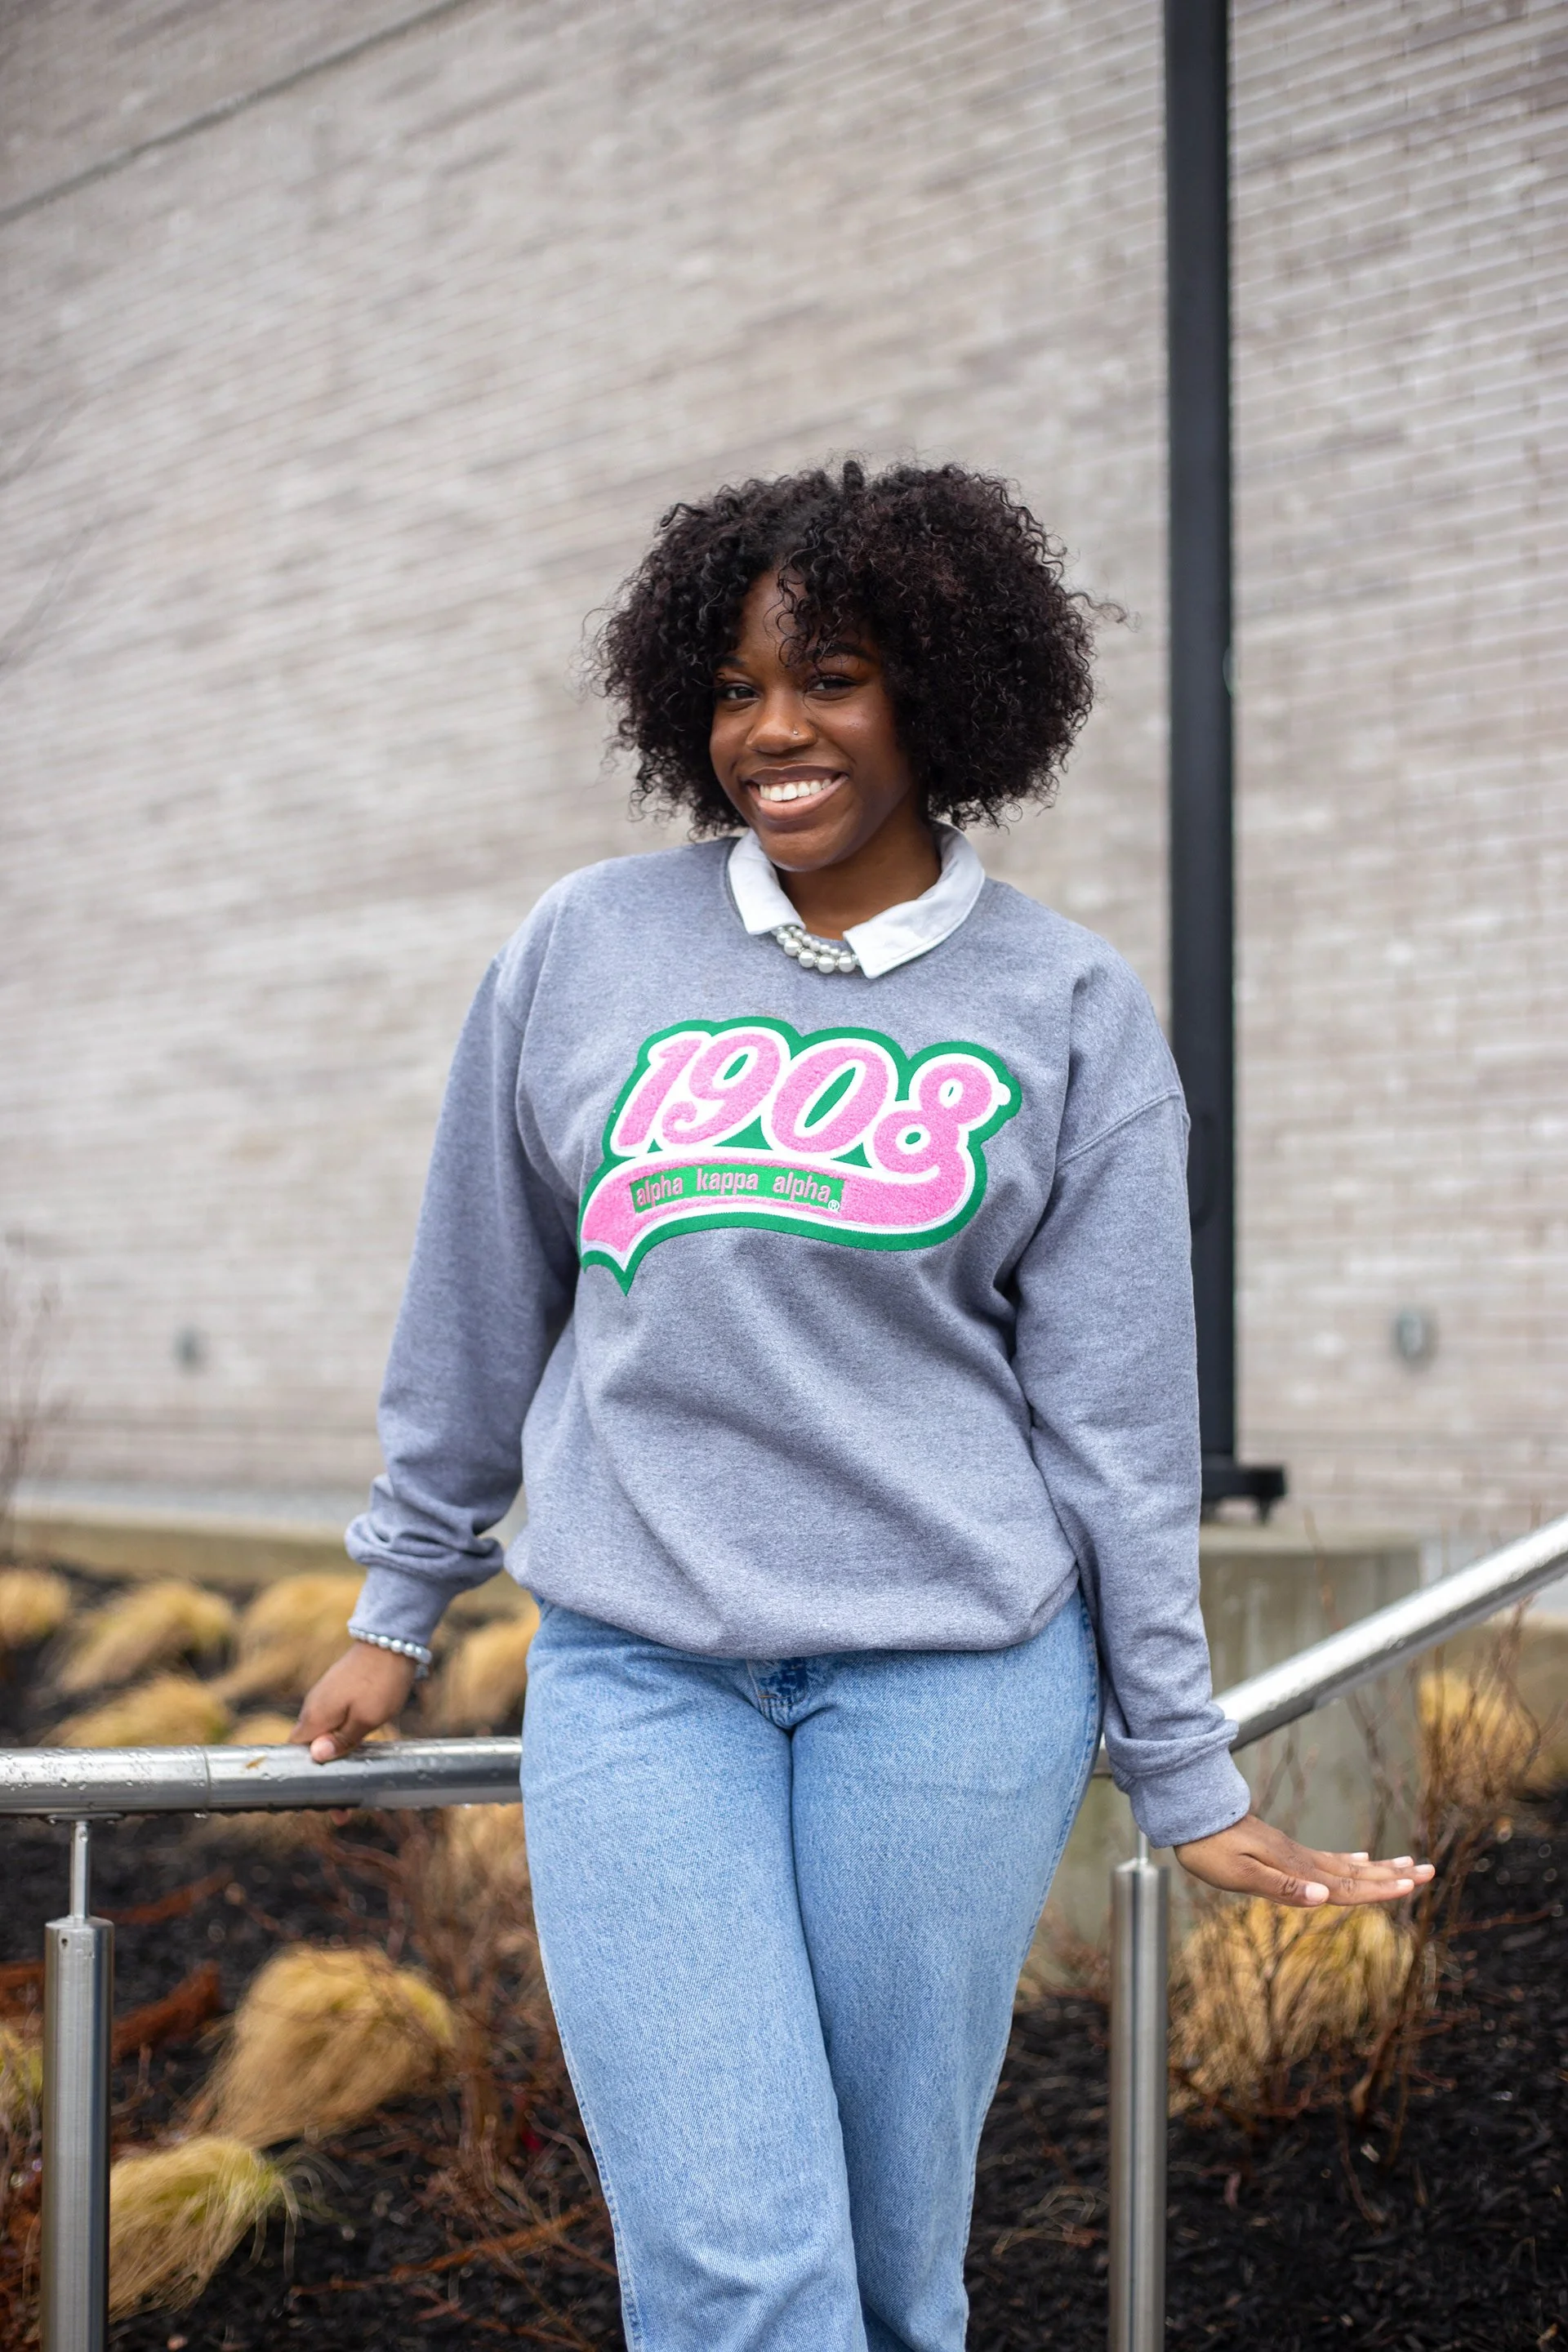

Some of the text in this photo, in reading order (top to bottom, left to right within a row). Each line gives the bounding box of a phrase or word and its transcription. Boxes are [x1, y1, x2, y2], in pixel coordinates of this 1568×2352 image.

[612, 1027, 1000, 1179] 1908
[636, 1174, 684, 1207] alpha
[696, 1168, 759, 1195] kappa
